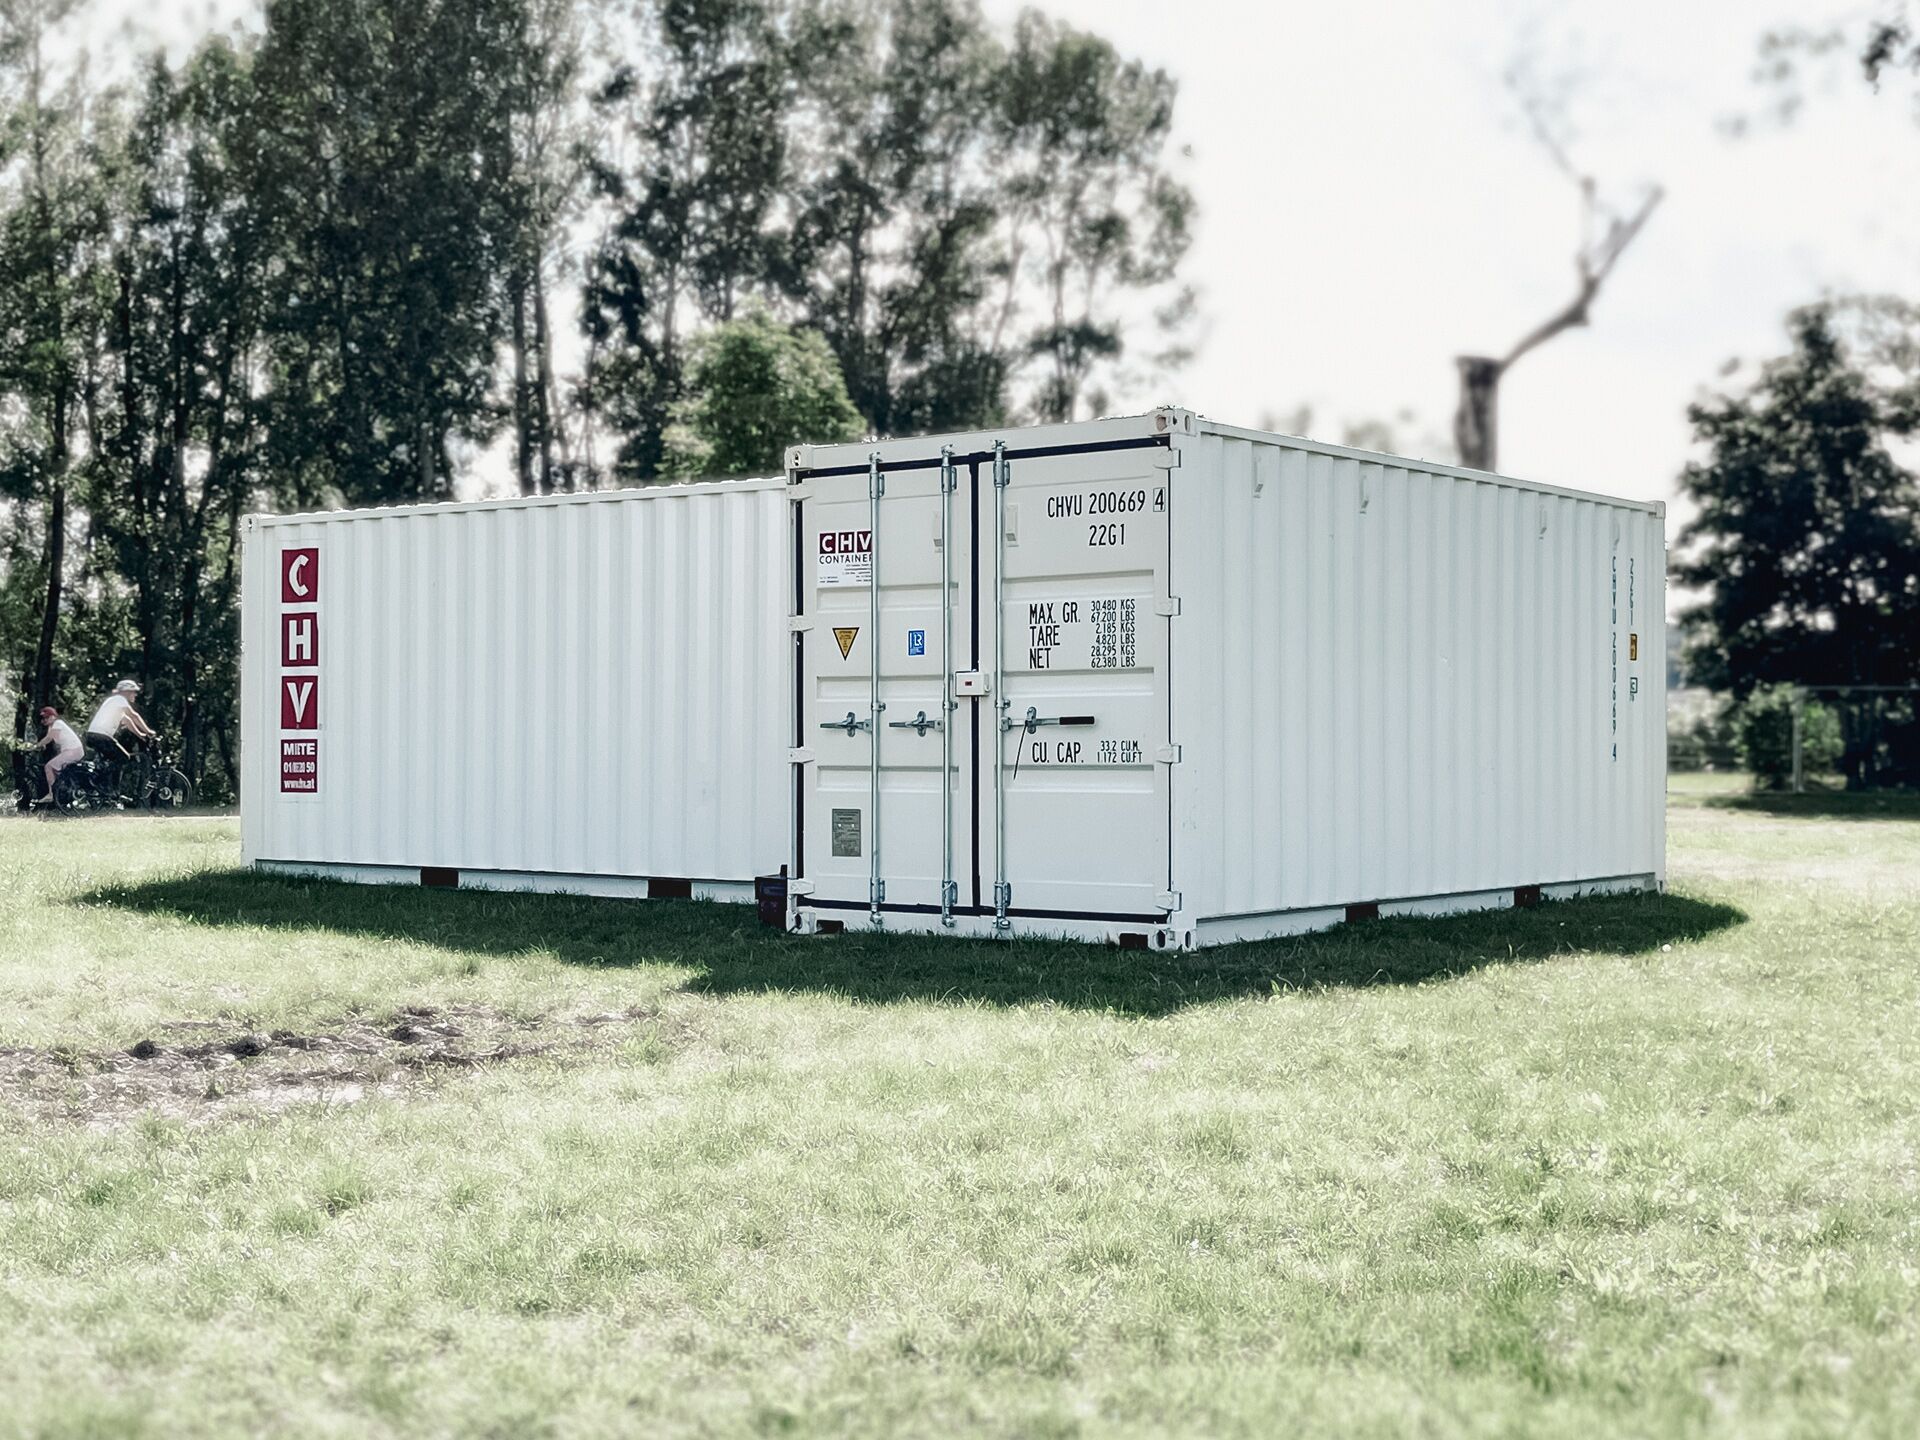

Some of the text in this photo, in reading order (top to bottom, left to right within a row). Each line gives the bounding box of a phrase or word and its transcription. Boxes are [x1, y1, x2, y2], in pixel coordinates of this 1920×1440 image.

[1047, 488, 1165, 518] CHVU 200669 4
[821, 533, 872, 552] CHV
[1089, 523, 1125, 547] 22G1
[1120, 599, 1136, 610] KGS
[1029, 602, 1081, 625] MAX. GR.
[1120, 610, 1136, 621] LBS
[1120, 622, 1136, 633] KGS
[1029, 625, 1061, 647] TARE
[1120, 633, 1136, 644] LBS
[1120, 645, 1136, 656] KGS
[1029, 648, 1051, 669] NET
[1120, 656, 1136, 667] LBS
[1032, 741, 1084, 763] CU. CAP.
[1100, 741, 1117, 752] 33.2
